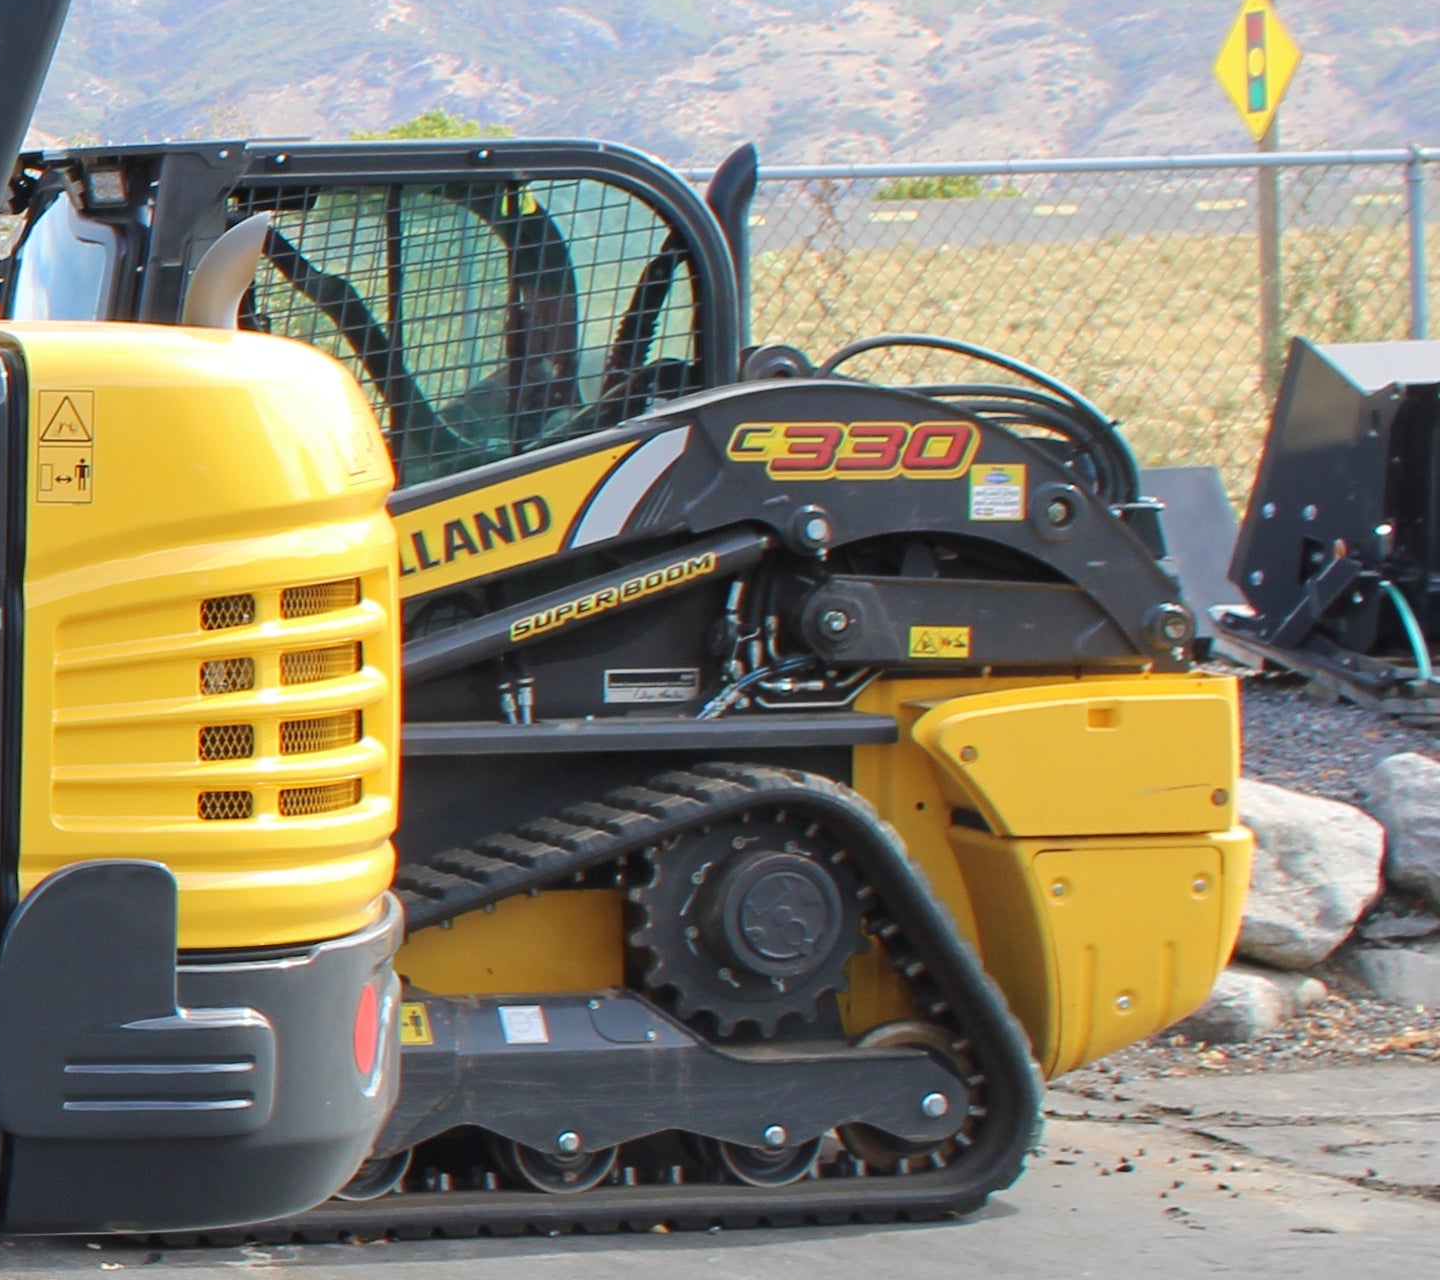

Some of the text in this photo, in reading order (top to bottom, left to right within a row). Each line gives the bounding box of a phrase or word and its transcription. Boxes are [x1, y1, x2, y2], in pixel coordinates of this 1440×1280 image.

[727, 421, 980, 480] C330
[511, 551, 718, 641] SUPER BOOM
